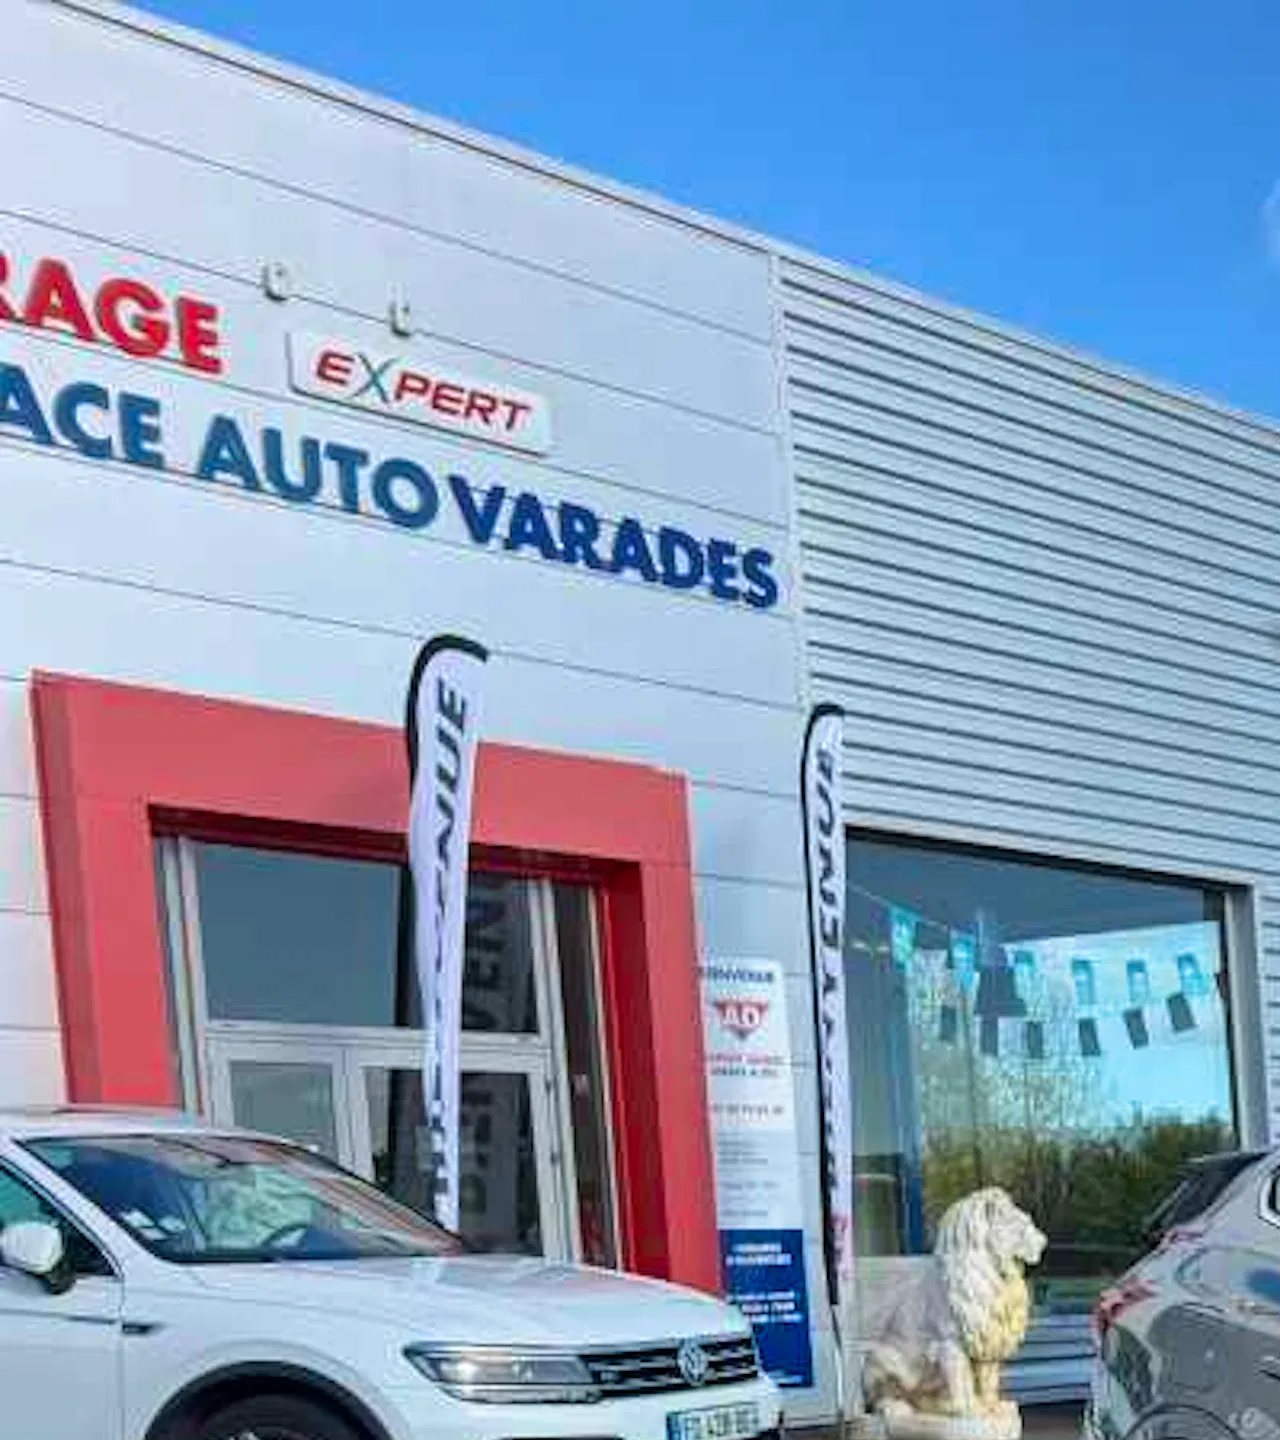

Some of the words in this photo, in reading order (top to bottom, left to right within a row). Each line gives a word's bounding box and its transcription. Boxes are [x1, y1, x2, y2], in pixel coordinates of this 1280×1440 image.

[316, 349, 532, 431] EXPERT
[196, 414, 438, 529] AUTO
[448, 474, 778, 608] VARADES
